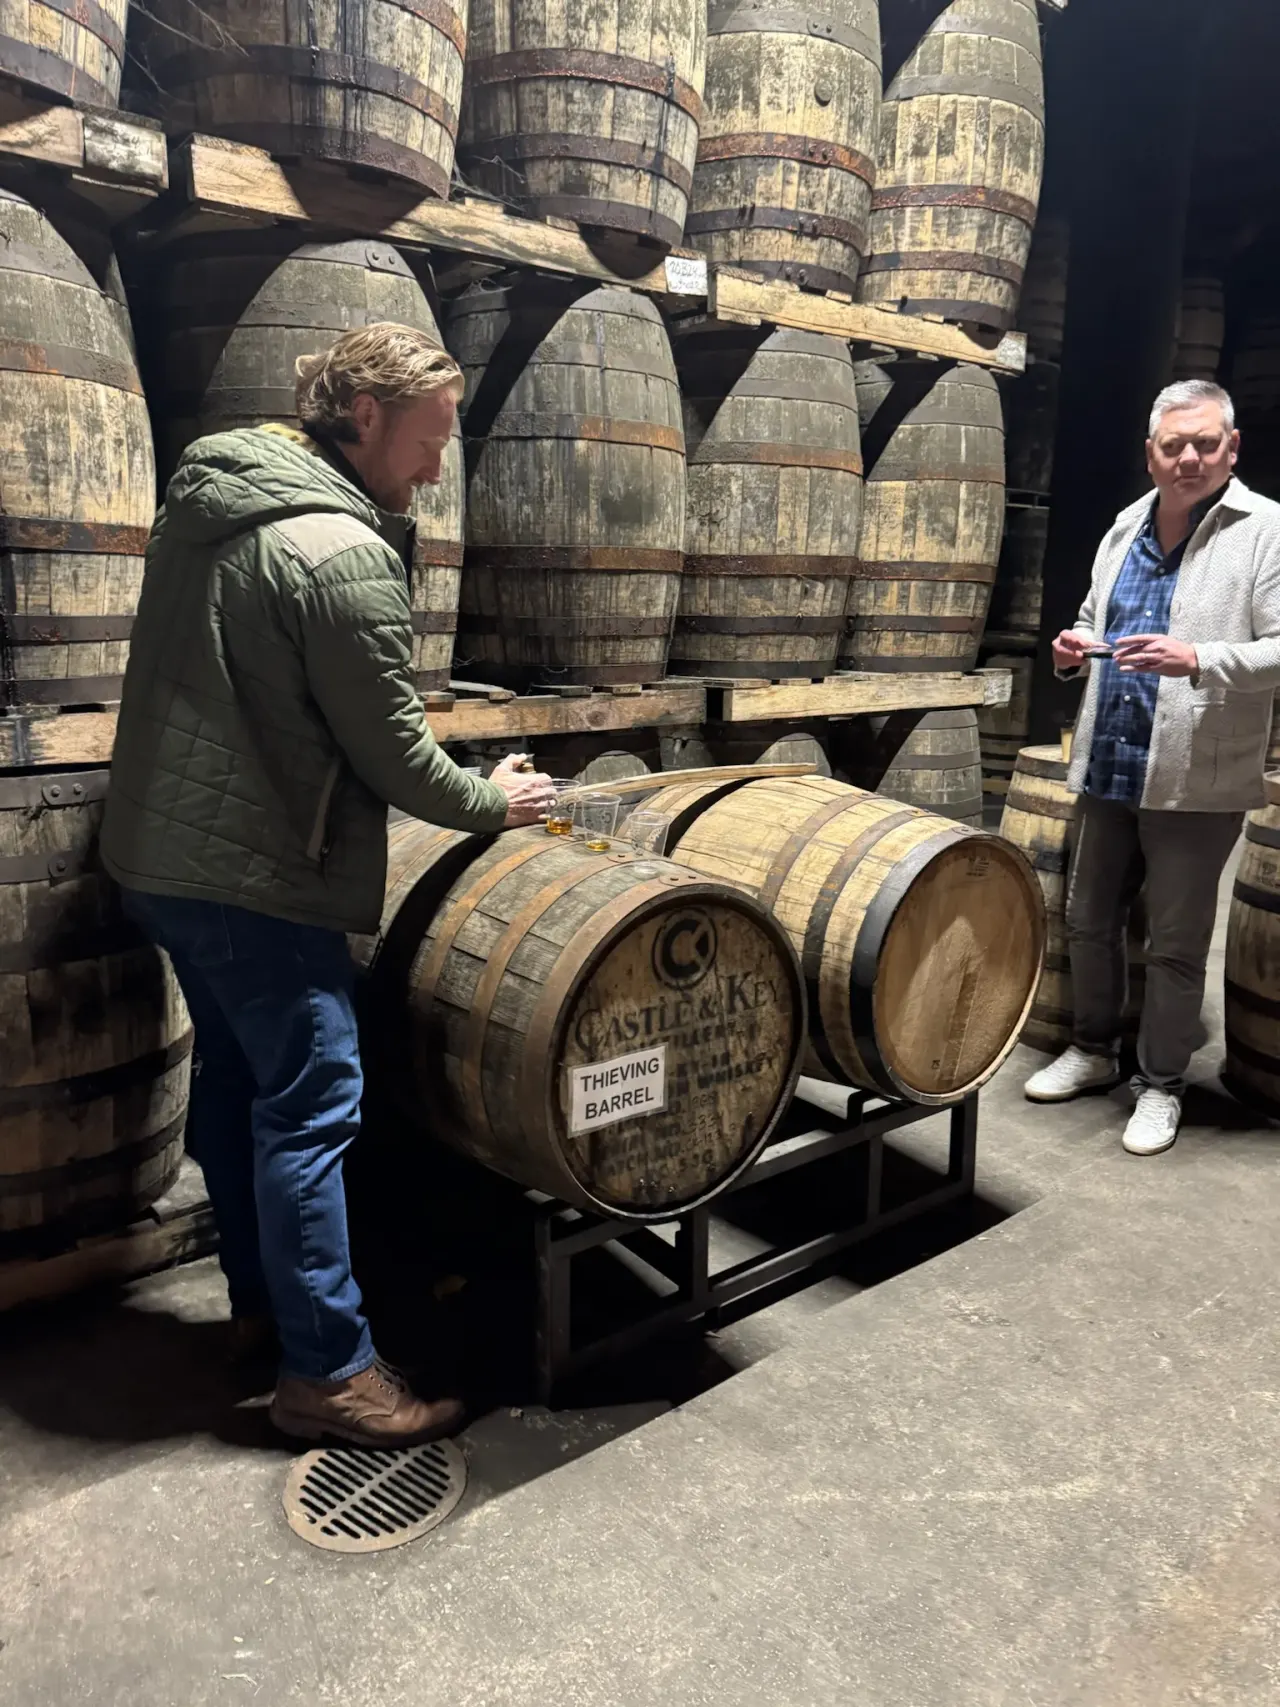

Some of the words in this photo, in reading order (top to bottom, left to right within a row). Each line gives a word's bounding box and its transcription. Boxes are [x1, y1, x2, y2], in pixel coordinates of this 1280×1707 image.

[575, 997, 694, 1050] CASTLE
[725, 972, 778, 1014] KEY
[580, 1057, 660, 1092] THIEVING
[585, 1086, 655, 1120] BARREL
